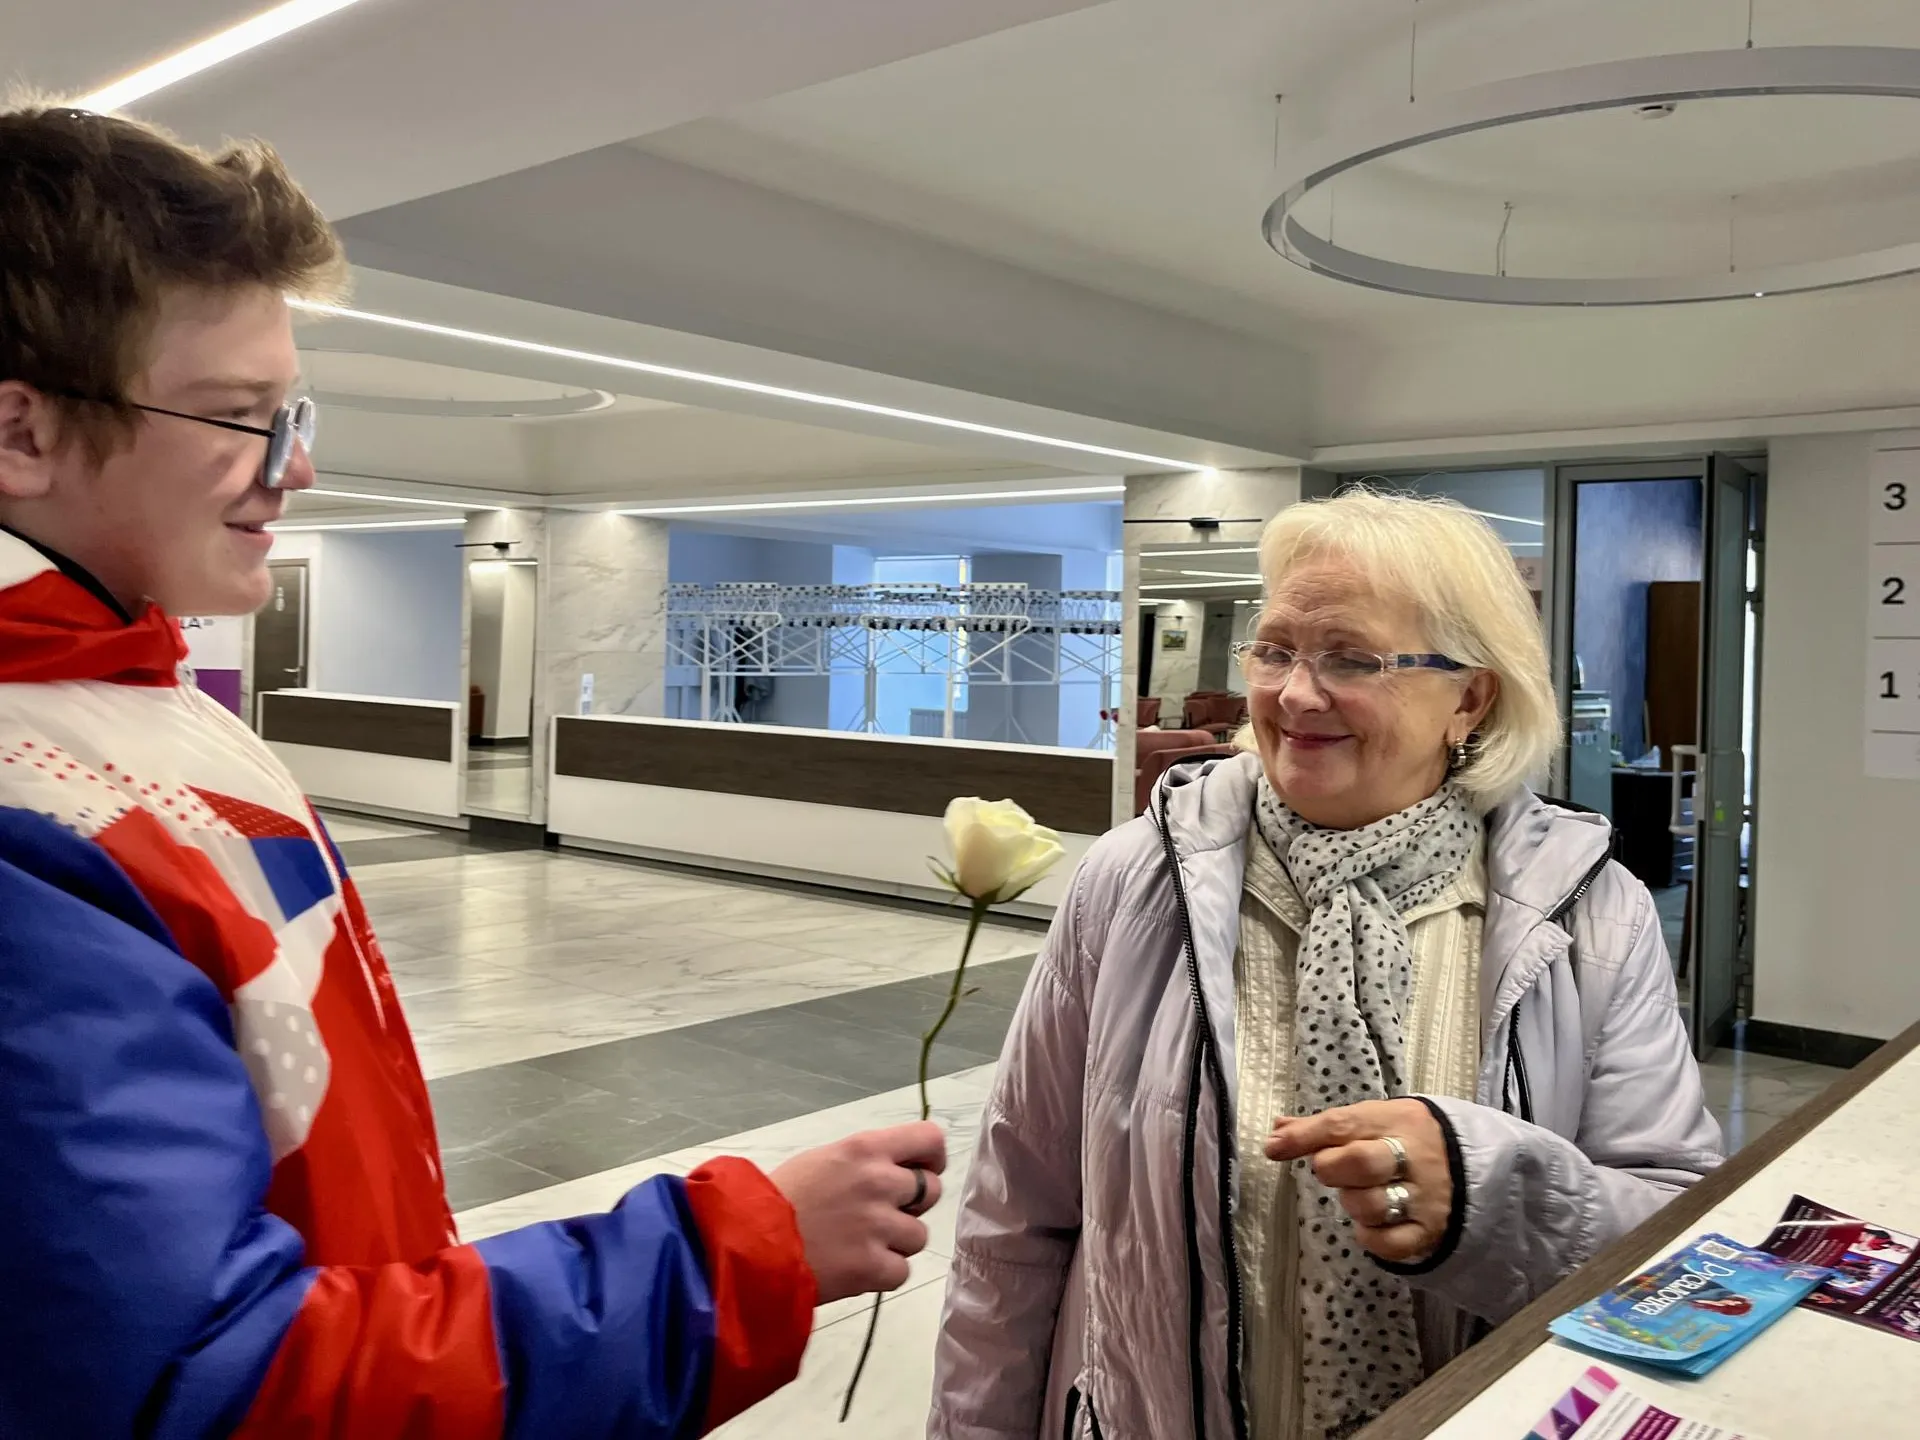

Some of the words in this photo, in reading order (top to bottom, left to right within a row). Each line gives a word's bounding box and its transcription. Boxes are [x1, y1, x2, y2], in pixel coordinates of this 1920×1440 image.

[1883, 482, 1907, 511] 3
[1881, 577, 1905, 605] 2
[1880, 671, 1900, 699] 1
